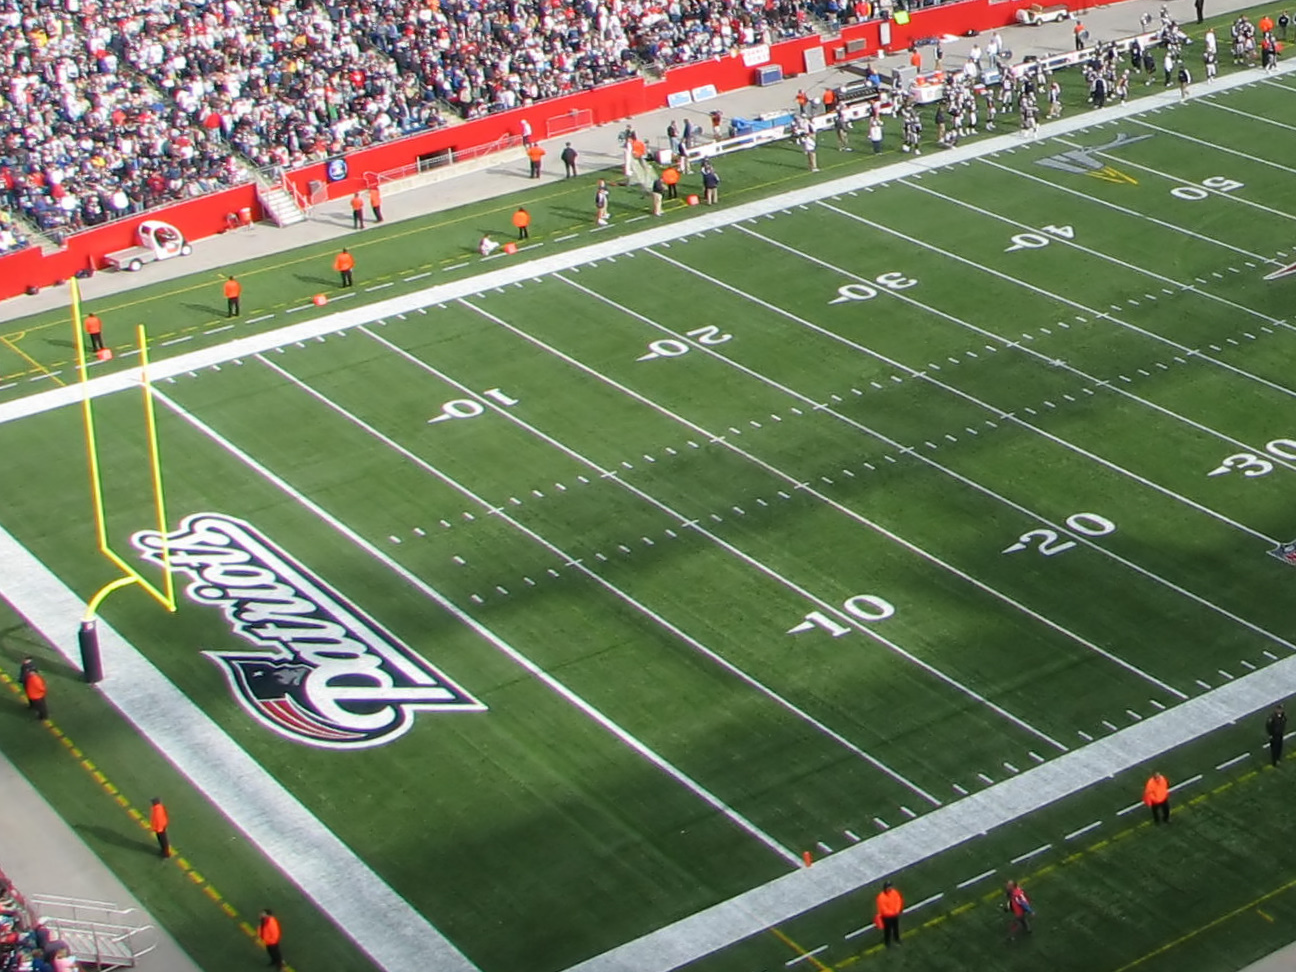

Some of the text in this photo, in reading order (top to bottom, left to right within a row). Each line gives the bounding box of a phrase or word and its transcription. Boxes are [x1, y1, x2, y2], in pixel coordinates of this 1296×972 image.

[1170, 176, 1244, 201] 50
[1010, 223, 1077, 252] 40
[836, 271, 919, 303] 30
[644, 324, 733, 360] 20
[440, 387, 519, 421] 10
[1016, 512, 1116, 556] 20
[798, 594, 896, 638] 10
